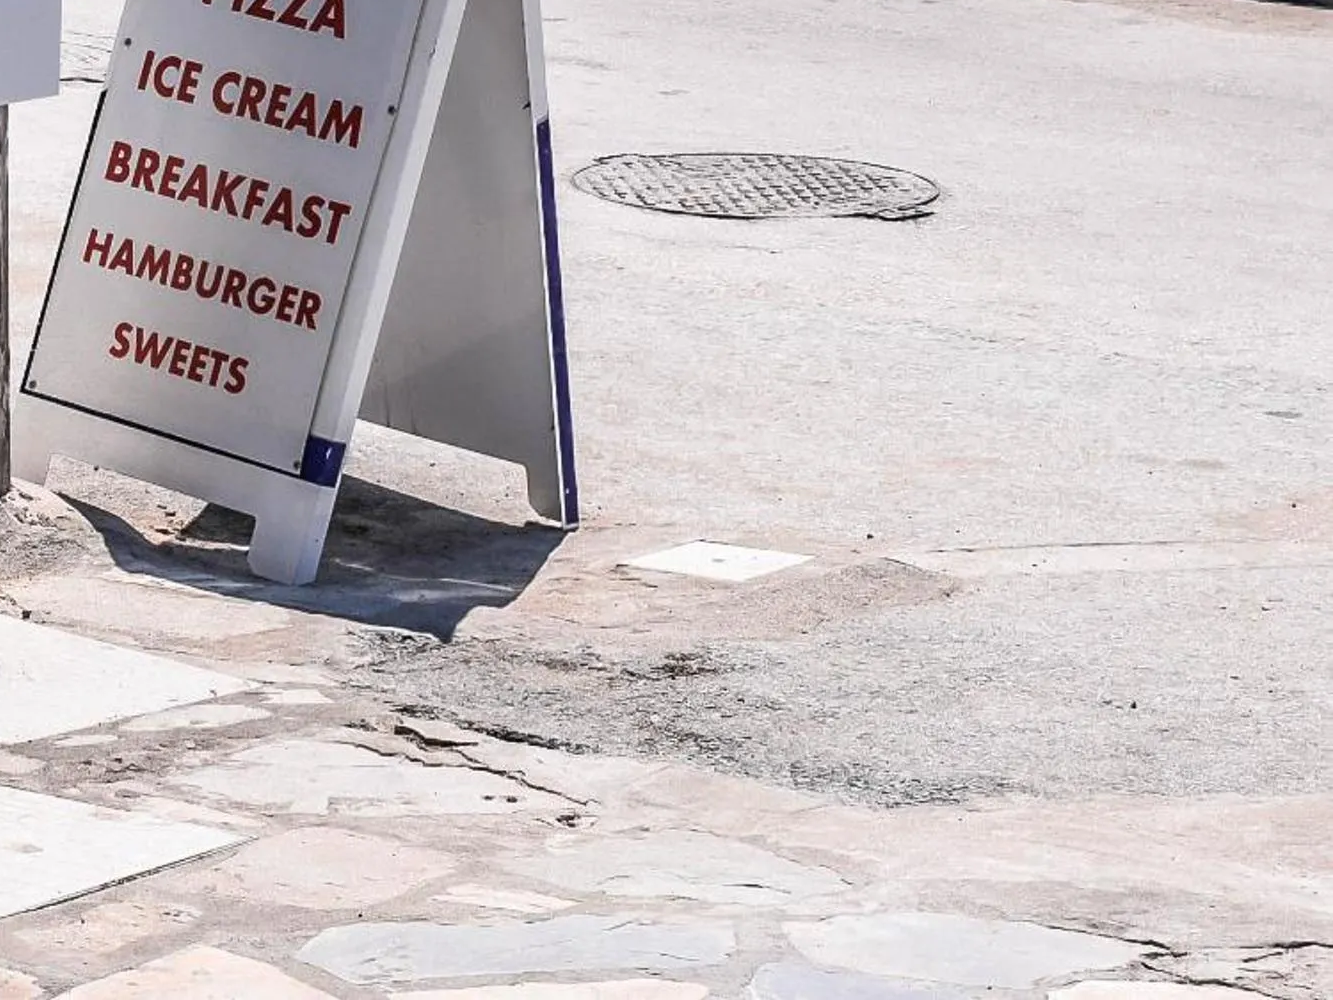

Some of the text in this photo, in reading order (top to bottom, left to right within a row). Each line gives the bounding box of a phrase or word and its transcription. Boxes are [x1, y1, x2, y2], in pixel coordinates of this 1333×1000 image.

[136, 49, 365, 150] ICE CREAM
[104, 139, 352, 245] BREAKFAST
[81, 227, 323, 331] HAMBURGER
[108, 320, 250, 395] SWEETS
